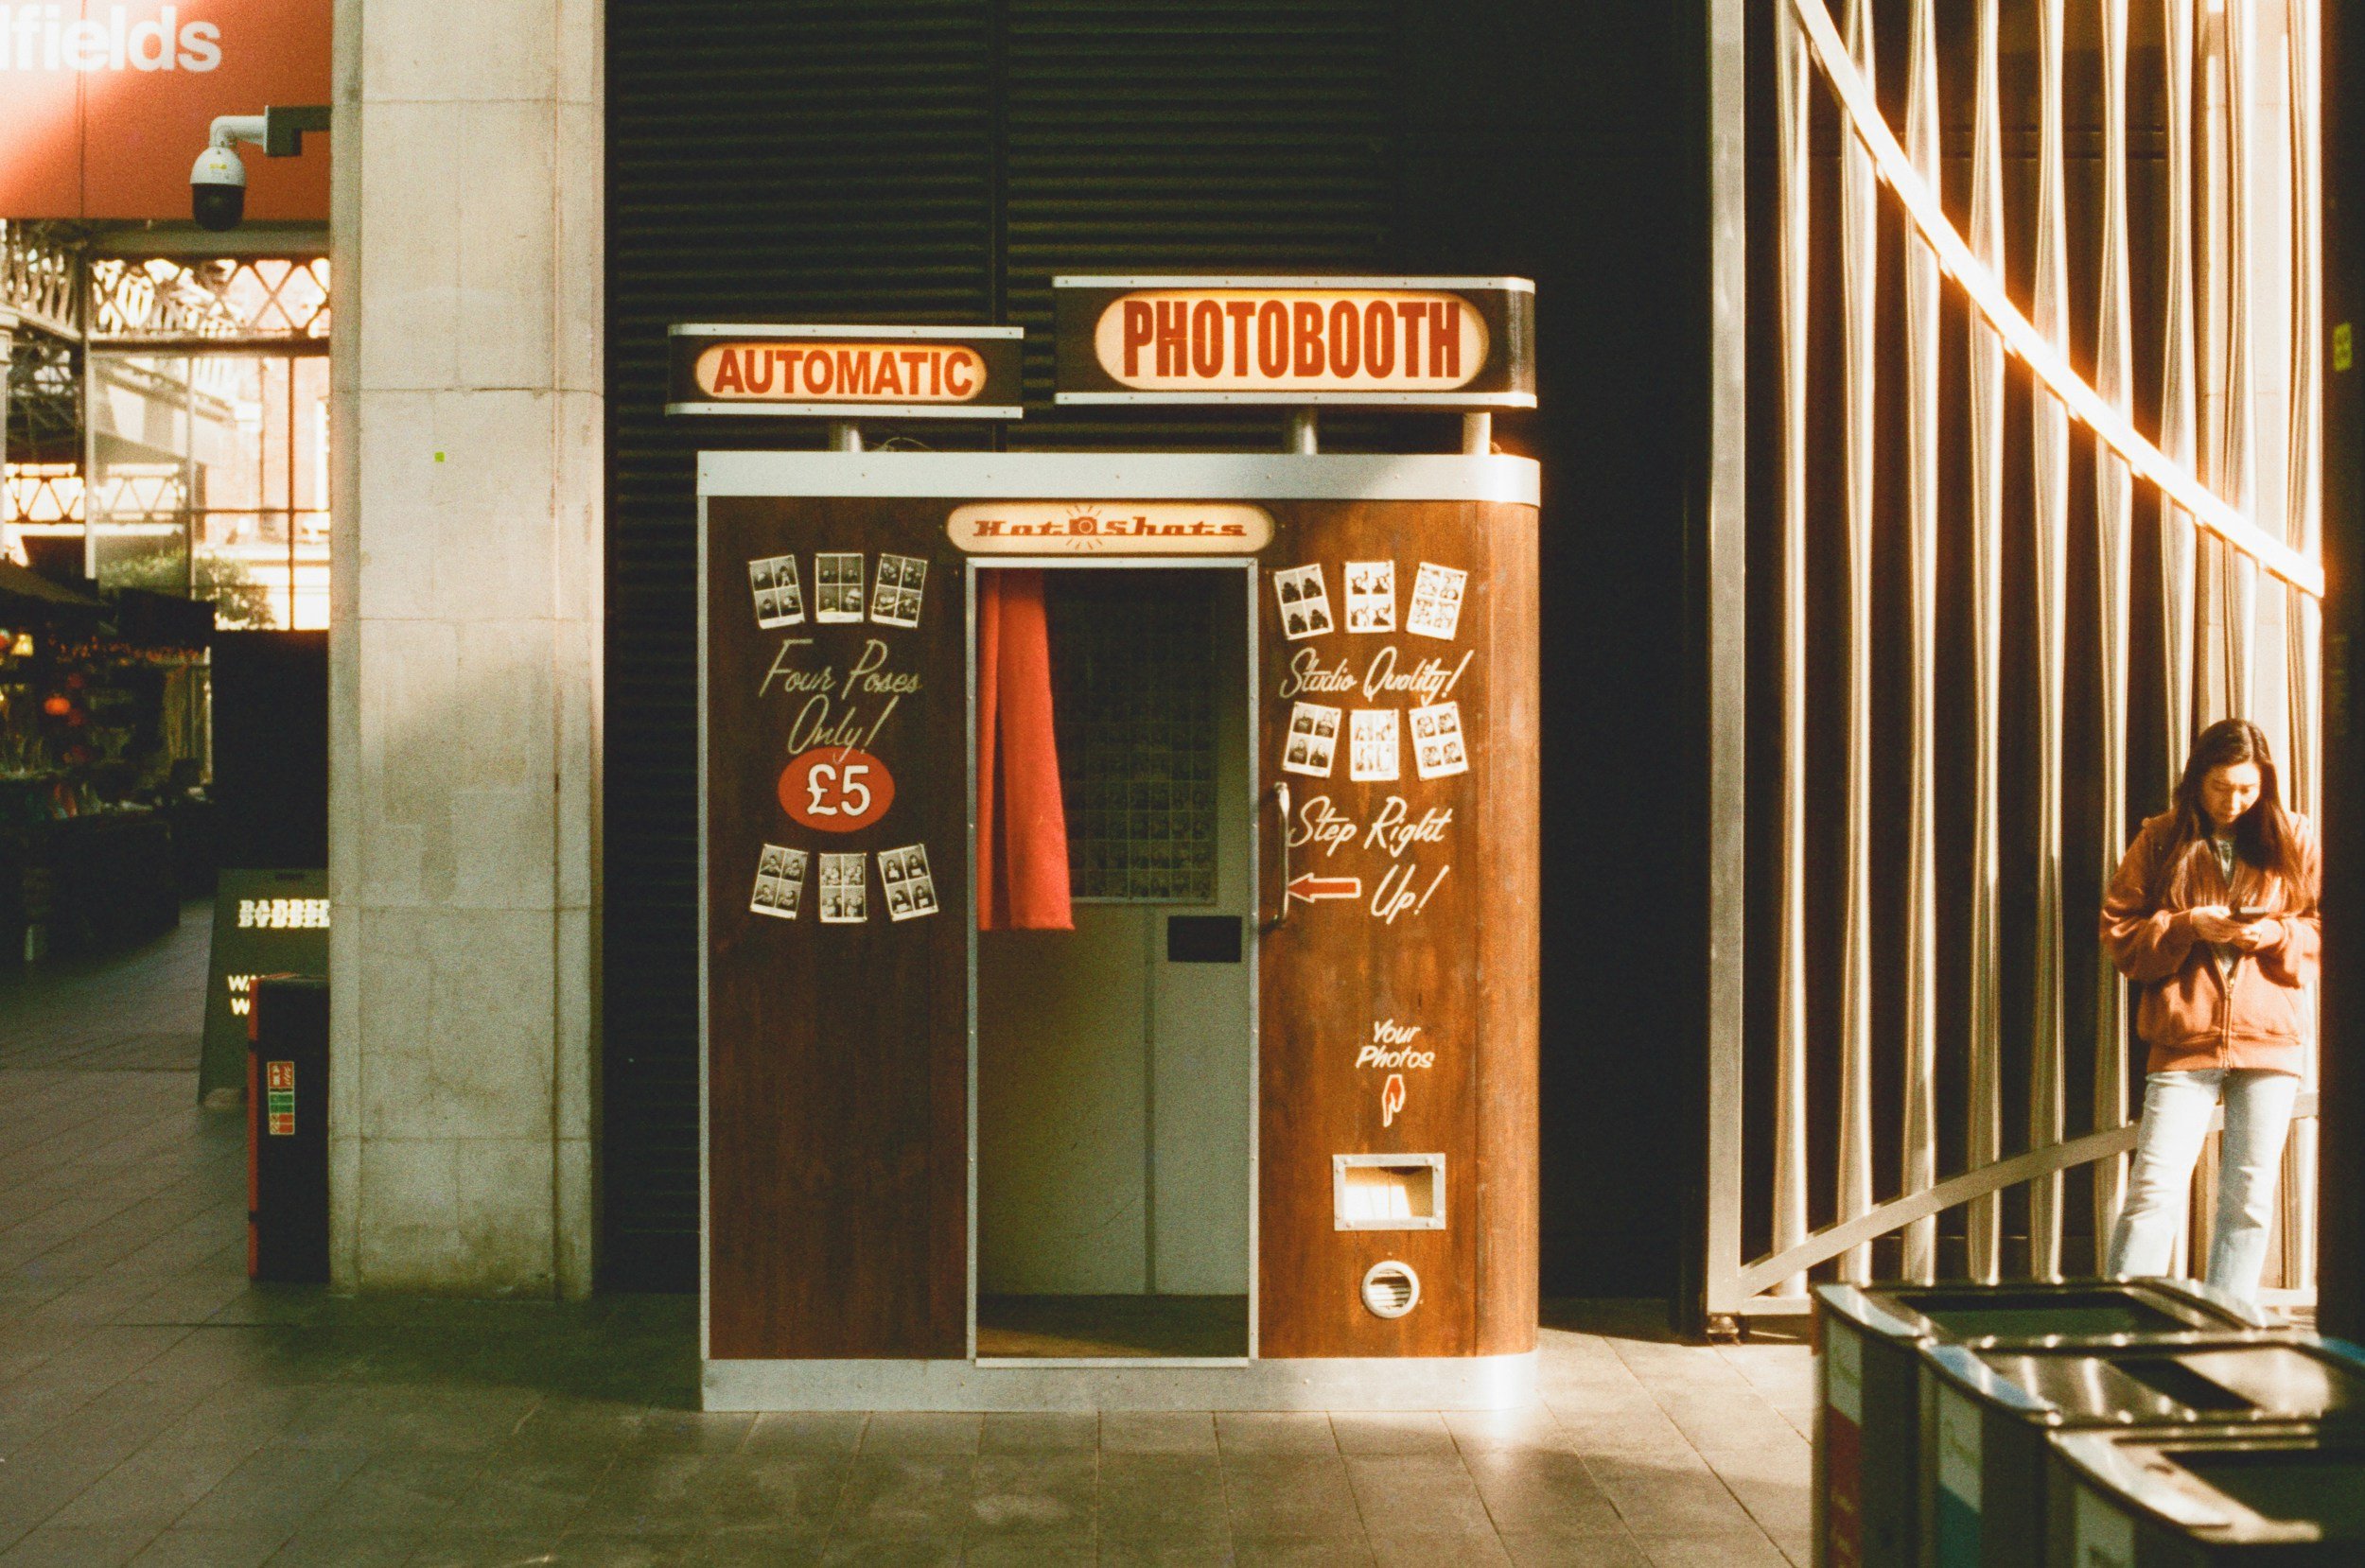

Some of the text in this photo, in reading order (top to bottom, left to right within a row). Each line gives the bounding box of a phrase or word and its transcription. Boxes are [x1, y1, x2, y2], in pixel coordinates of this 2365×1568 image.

[1124, 299, 1462, 379] PHOTOBOOTH
[713, 347, 974, 398] AUTOMATIC
[973, 516, 1247, 536] Hot Shots
[759, 638, 922, 701] Four Poses
[1279, 646, 1475, 706] Studio Quality!
[787, 693, 900, 765] Only!
[806, 763, 871, 816] £5
[1288, 795, 1453, 858] Step Right
[1371, 864, 1450, 925] Up!
[1355, 1044, 1436, 1069] Photos
[1372, 1019, 1422, 1044] Your
